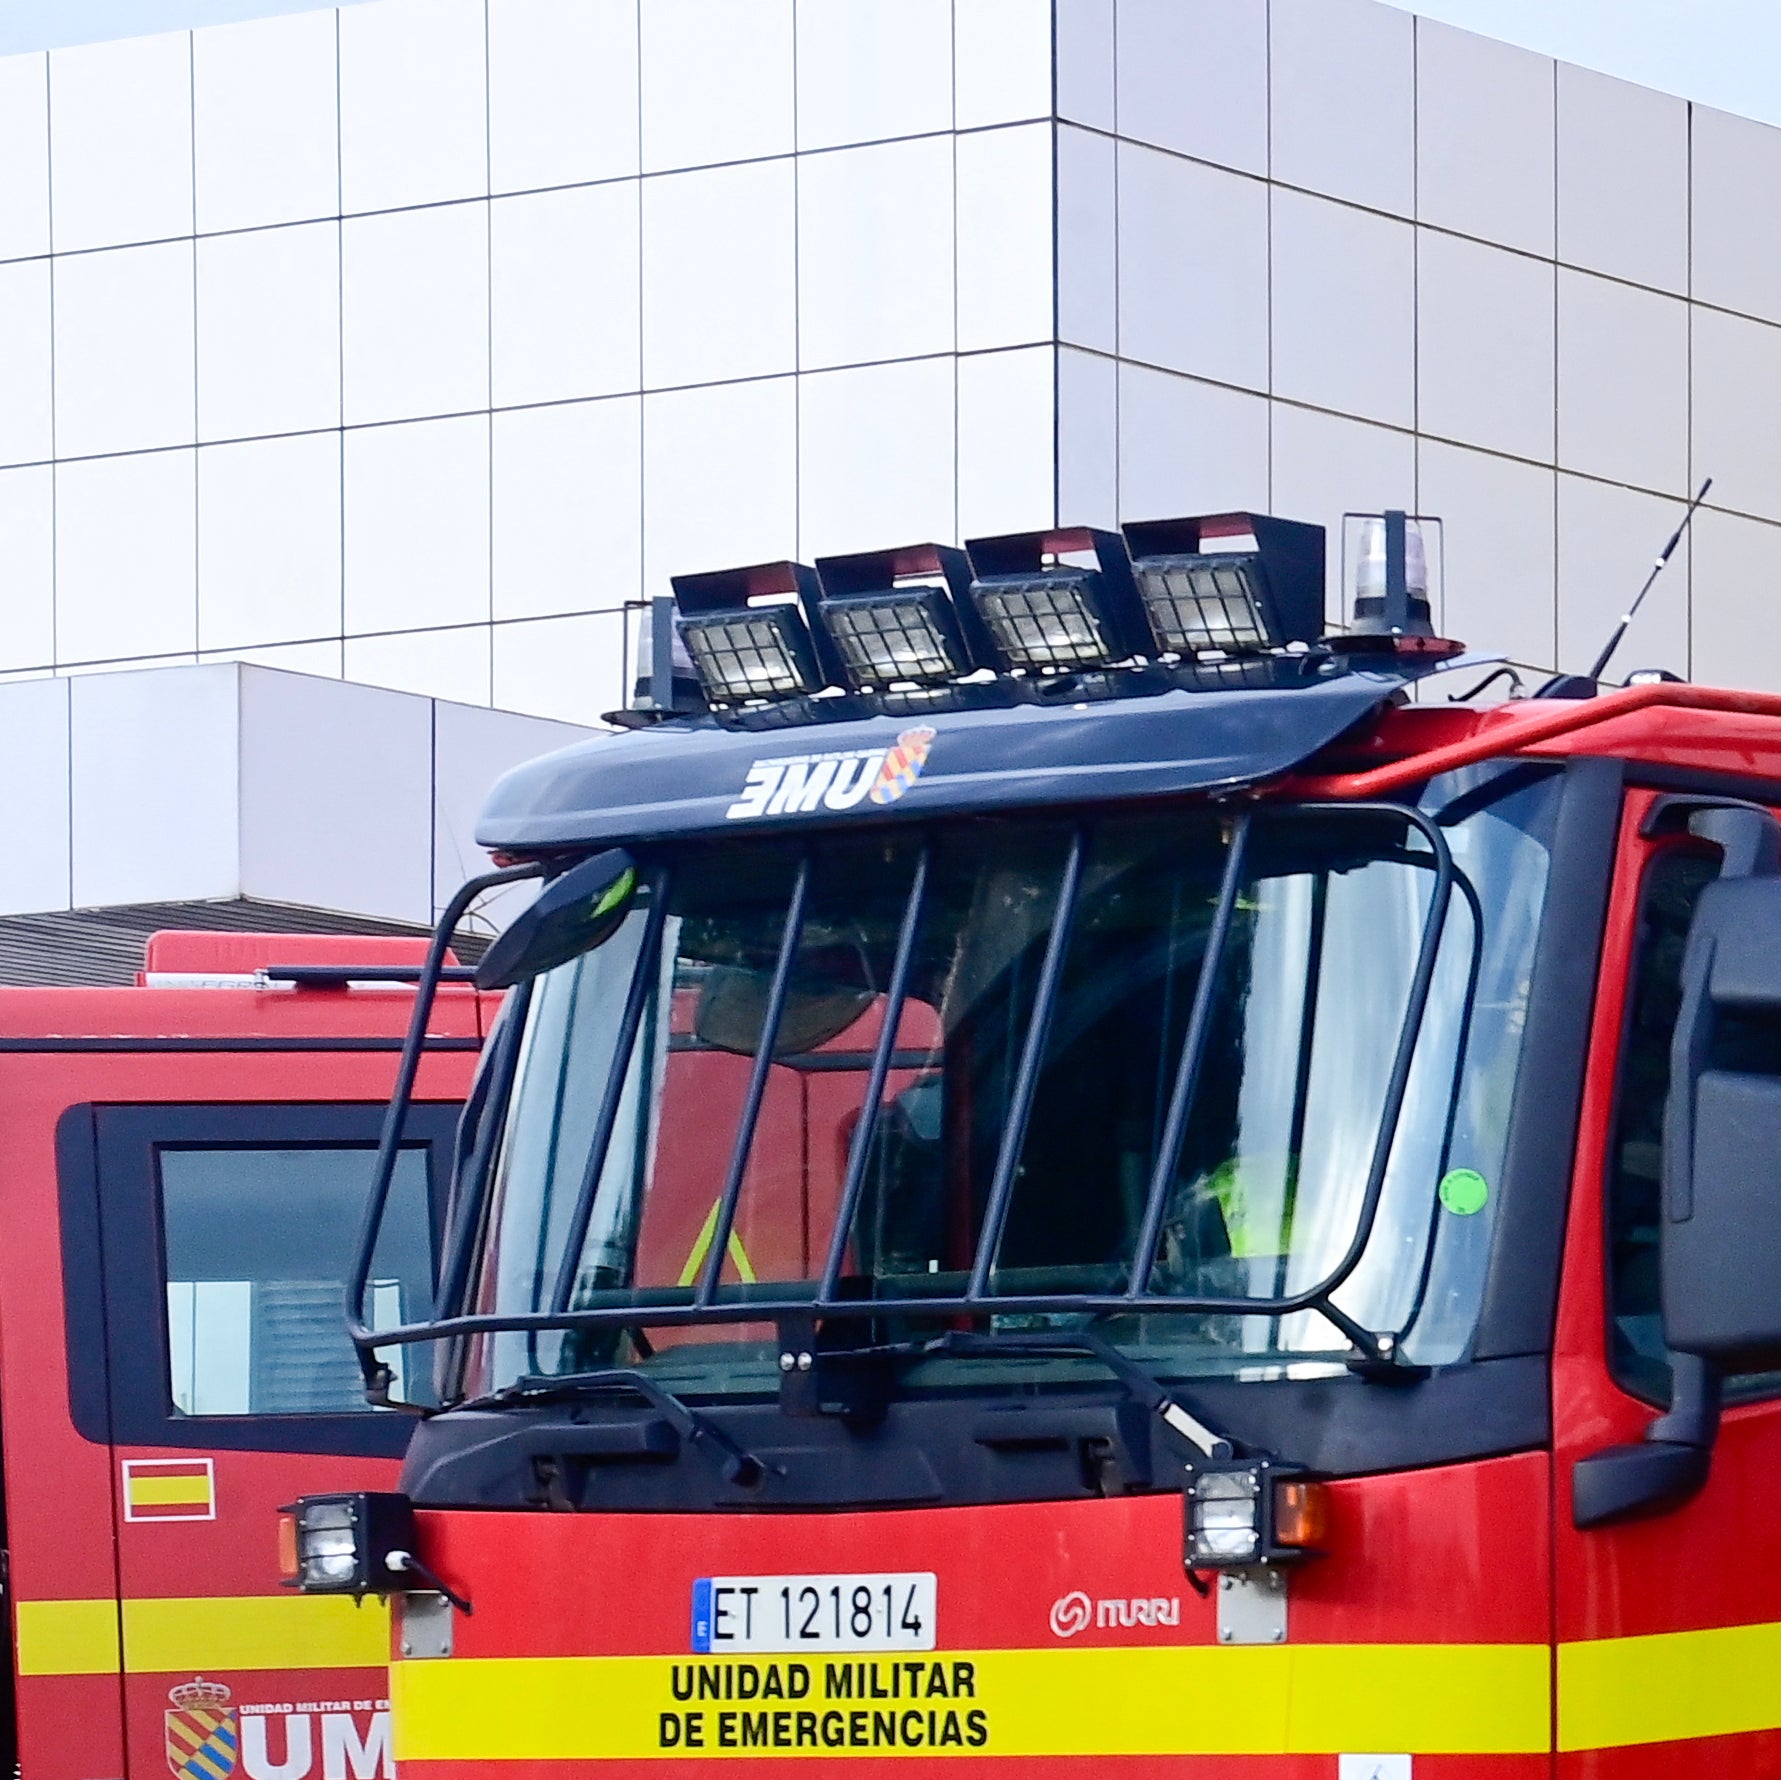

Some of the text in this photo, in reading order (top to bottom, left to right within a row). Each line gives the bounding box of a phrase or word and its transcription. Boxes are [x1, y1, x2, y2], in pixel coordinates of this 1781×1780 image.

[714, 1584, 922, 1640] ET 121814
[671, 1661, 977, 1701] UNIDAD MILITAR
[239, 1704, 294, 1714] UNIDAD
[353, 1701, 373, 1711] DE
[658, 1709, 988, 1748] DE EMERGENCIAS
